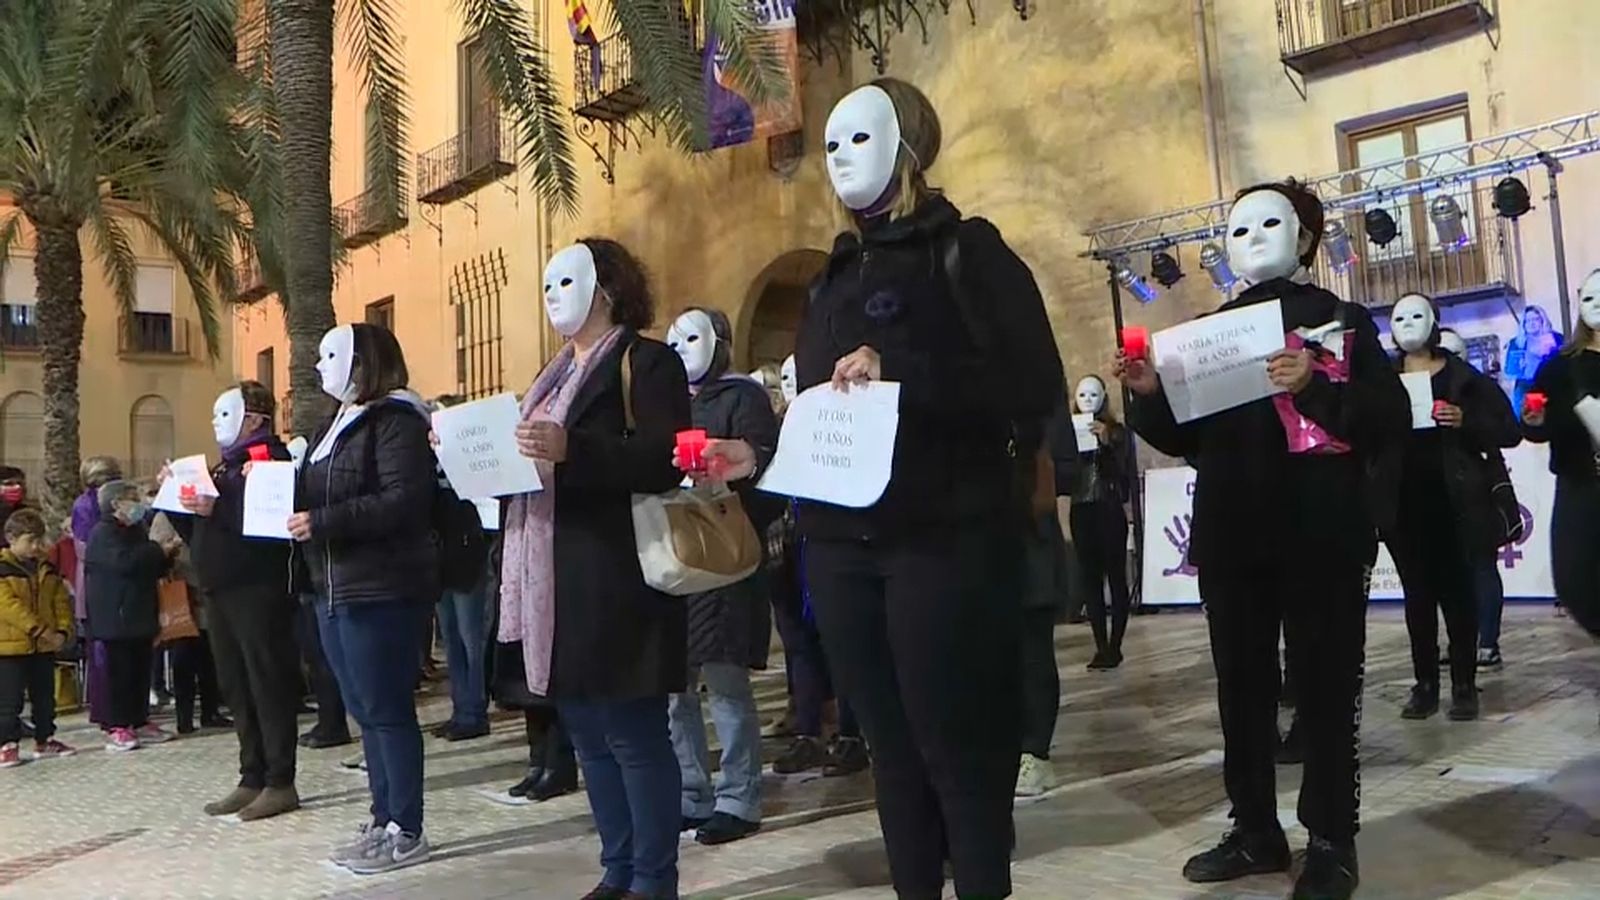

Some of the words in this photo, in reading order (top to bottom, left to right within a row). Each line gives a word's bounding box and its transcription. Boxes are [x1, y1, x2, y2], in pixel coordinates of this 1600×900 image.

[1211, 343, 1240, 361] AÑOS
[818, 408, 853, 424] FLORA
[826, 429, 854, 447] AÑOS
[810, 453, 852, 468] MADRID
